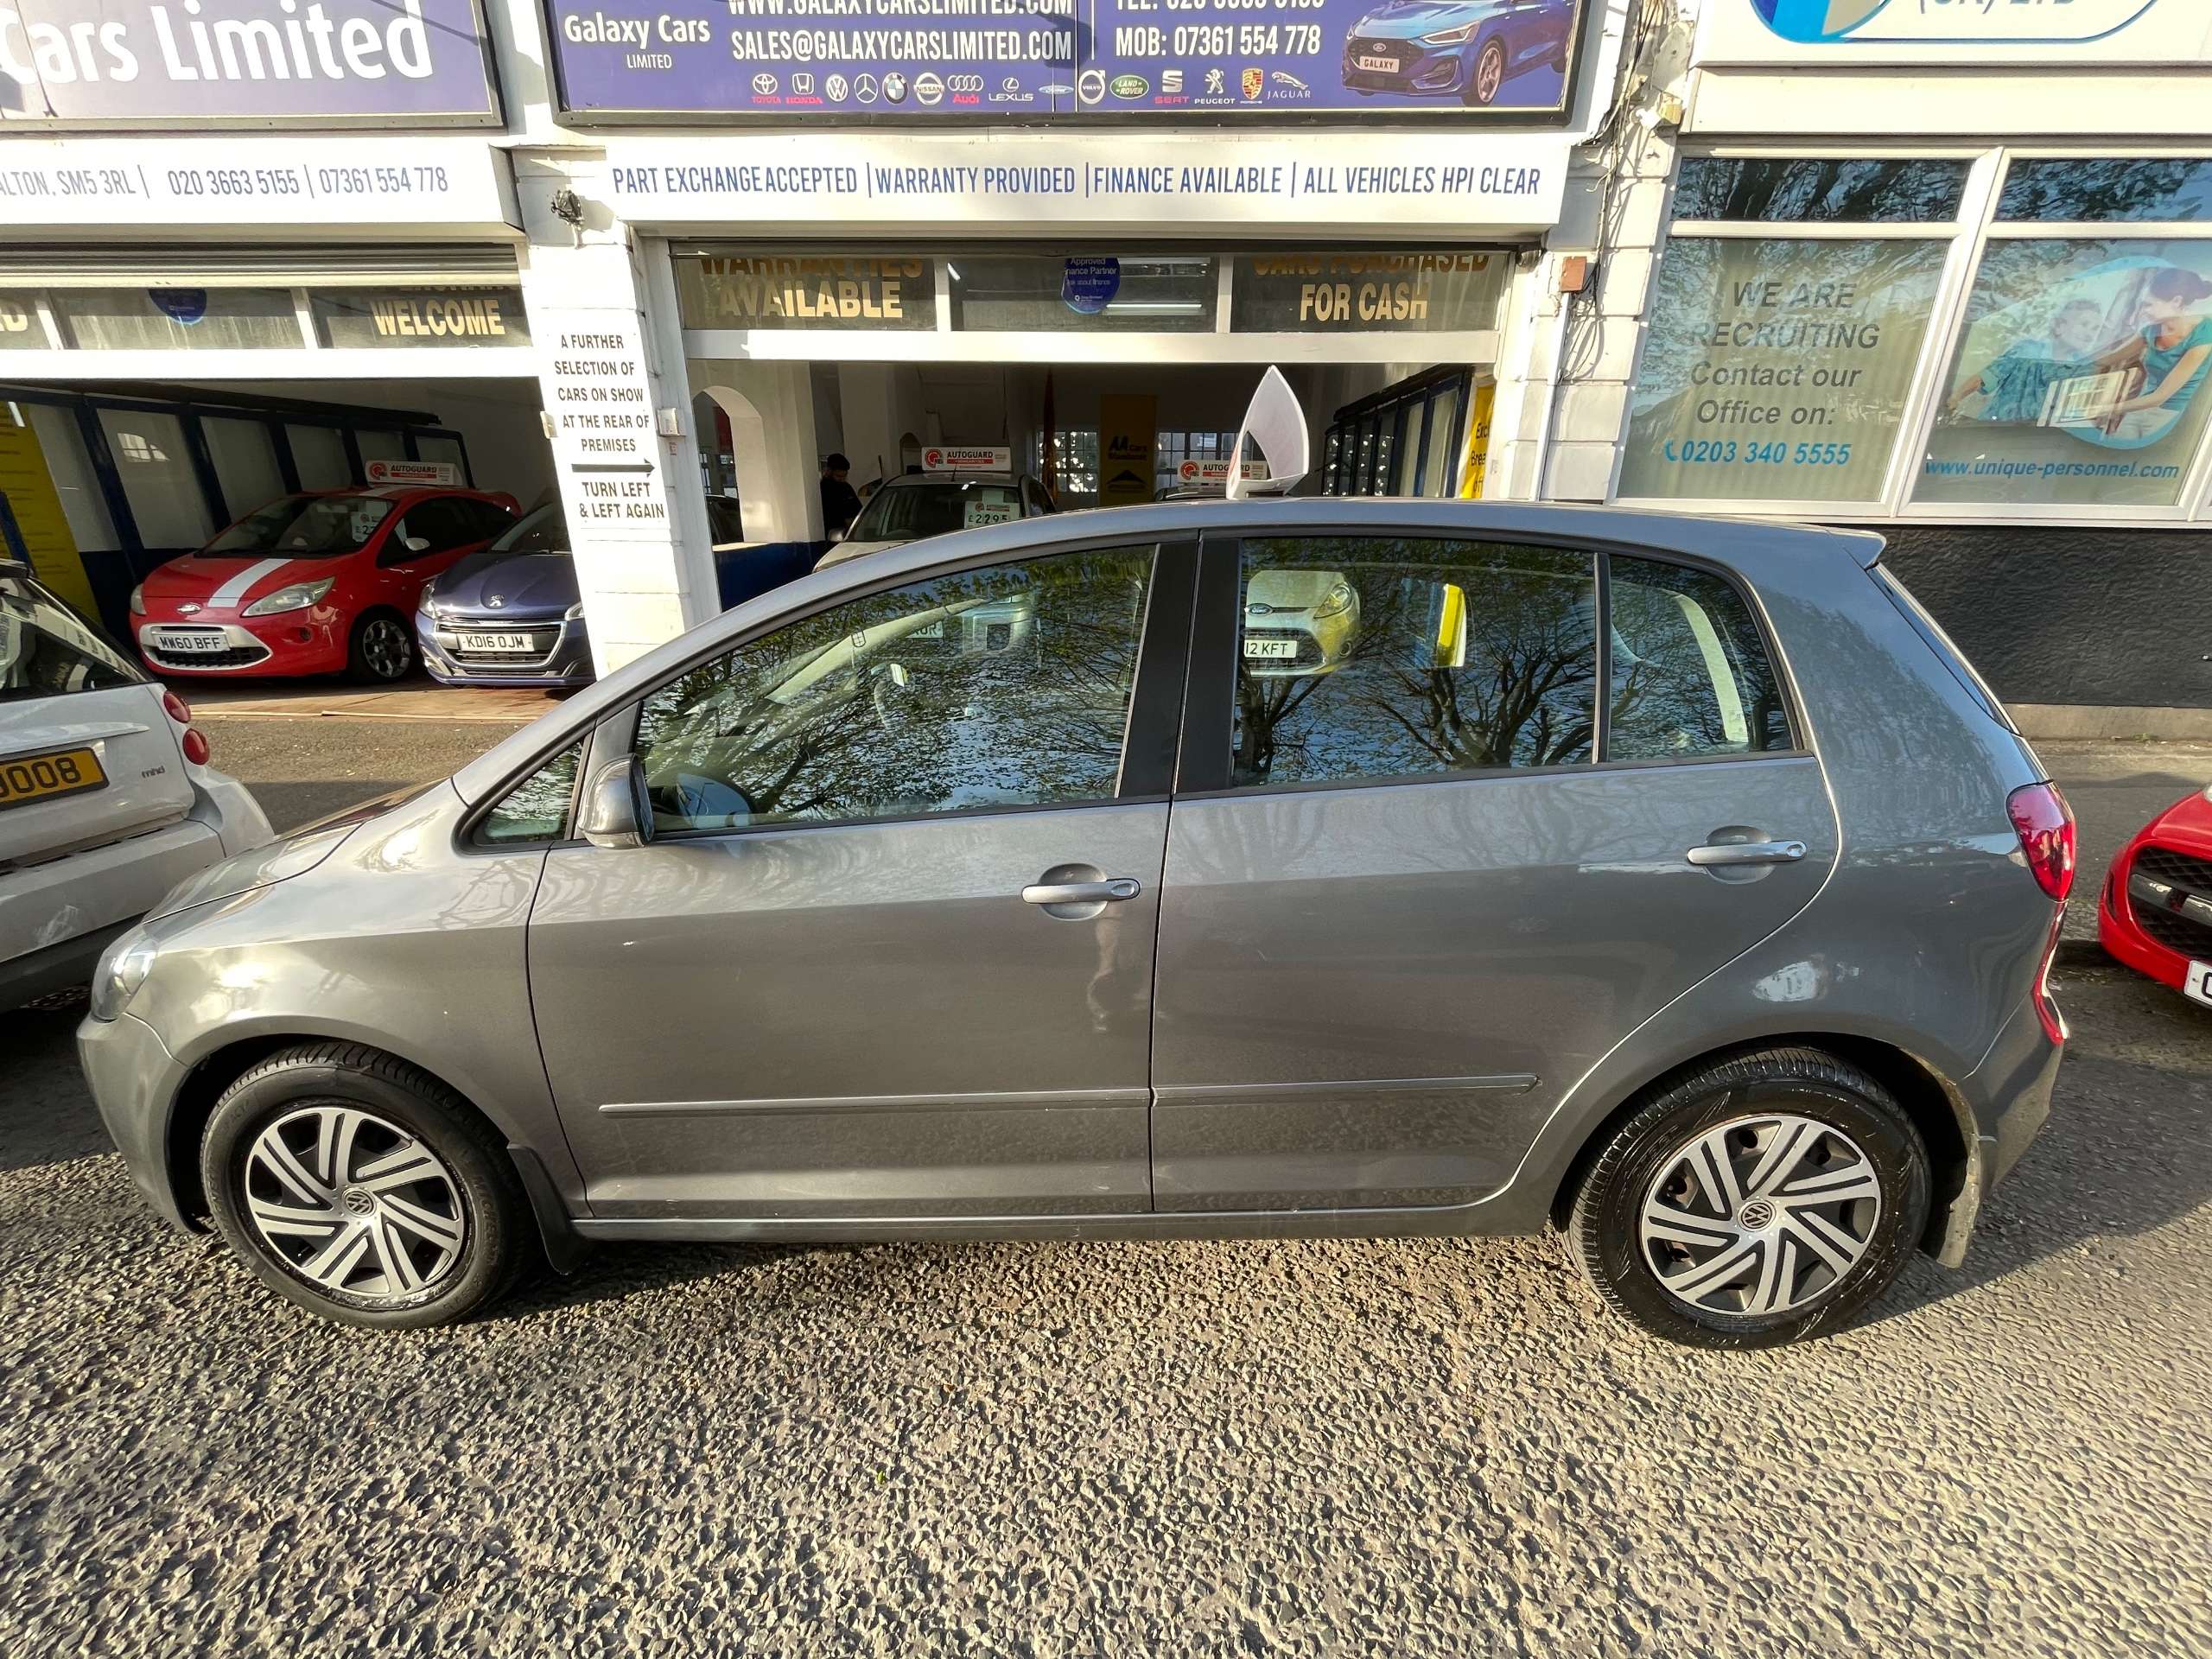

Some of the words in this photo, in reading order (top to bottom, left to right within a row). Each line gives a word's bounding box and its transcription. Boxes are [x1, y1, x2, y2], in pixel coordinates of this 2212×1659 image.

[0, 9, 138, 85] Cars
[149, 0, 434, 80] Limited
[564, 15, 648, 49] Galaxy
[658, 16, 710, 42] Cars
[1116, 27, 1166, 56] MOB:
[1174, 26, 1233, 55] 07361
[1240, 25, 1278, 55] 554
[1285, 25, 1321, 55] 778
[731, 29, 1071, 61] SALES@GALAXYCARSLIMITED.COM
[626, 54, 672, 69] LIMITED
[1363, 59, 1394, 70] GALAXY
[752, 96, 781, 105] TOYOTA
[785, 96, 823, 105] HONDA
[952, 93, 980, 104] Audi
[988, 92, 1034, 102] LEXUS
[1267, 90, 1312, 99] JAGUAR
[57, 170, 98, 196] SM5
[99, 169, 137, 194] 3RL
[168, 170, 204, 195] 020
[206, 169, 253, 195] 3663
[256, 169, 300, 194] 5155
[319, 168, 372, 194] 07361
[375, 167, 411, 193] 554
[414, 167, 448, 192] 778
[613, 168, 658, 194] PART
[666, 166, 762, 194] EXCHANGE
[765, 166, 857, 194] ACCEPTED
[876, 167, 977, 194] WARRANTY
[984, 166, 1075, 194] PROVIDED
[1094, 166, 1173, 194] FINANCE
[1179, 167, 1281, 194] AVAILABLE
[1304, 167, 1338, 194] ALL
[1345, 167, 1435, 194] VEHICLES
[1440, 167, 1473, 194] HPI
[1479, 168, 1541, 194] CLEAR
[1090, 266, 1117, 275] Partner
[719, 281, 903, 318] AVAILABLE
[1300, 283, 1351, 321] FOR
[1358, 283, 1427, 321] CASH
[1732, 282, 1782, 308] WE
[1790, 283, 1857, 309] ARE
[372, 299, 505, 336] WELCOME
[561, 334, 568, 349] A
[572, 334, 624, 349] FURTHER
[1691, 322, 1880, 350] RECRUITING
[554, 361, 617, 375] SELECTION
[621, 361, 634, 376] OF
[1691, 360, 1802, 387] Contact
[1811, 368, 1862, 388] our
[558, 387, 588, 402] CARS
[591, 388, 607, 402] ON
[611, 388, 643, 402] SHOW
[563, 415, 575, 428] AT
[578, 415, 600, 429] THE
[604, 415, 632, 429] REAR
[636, 415, 649, 429] OF
[1697, 400, 1781, 426] Office
[1790, 404, 1835, 426] on:
[581, 438, 636, 452] PREMISES
[1681, 440, 1737, 463] 0203
[1744, 441, 1787, 464] 340
[1793, 442, 1853, 466] 5555
[1925, 459, 2179, 479] www.unique-personnel.com
[582, 482, 617, 497] TURN
[621, 482, 650, 498] LEFT
[579, 503, 588, 518] &
[592, 503, 620, 518] LEFT
[626, 503, 664, 518] AGAIN
[194, 637, 220, 649] BFF
[466, 635, 495, 648] KD16
[498, 636, 524, 648] OJM
[1262, 642, 1287, 655] KFT
